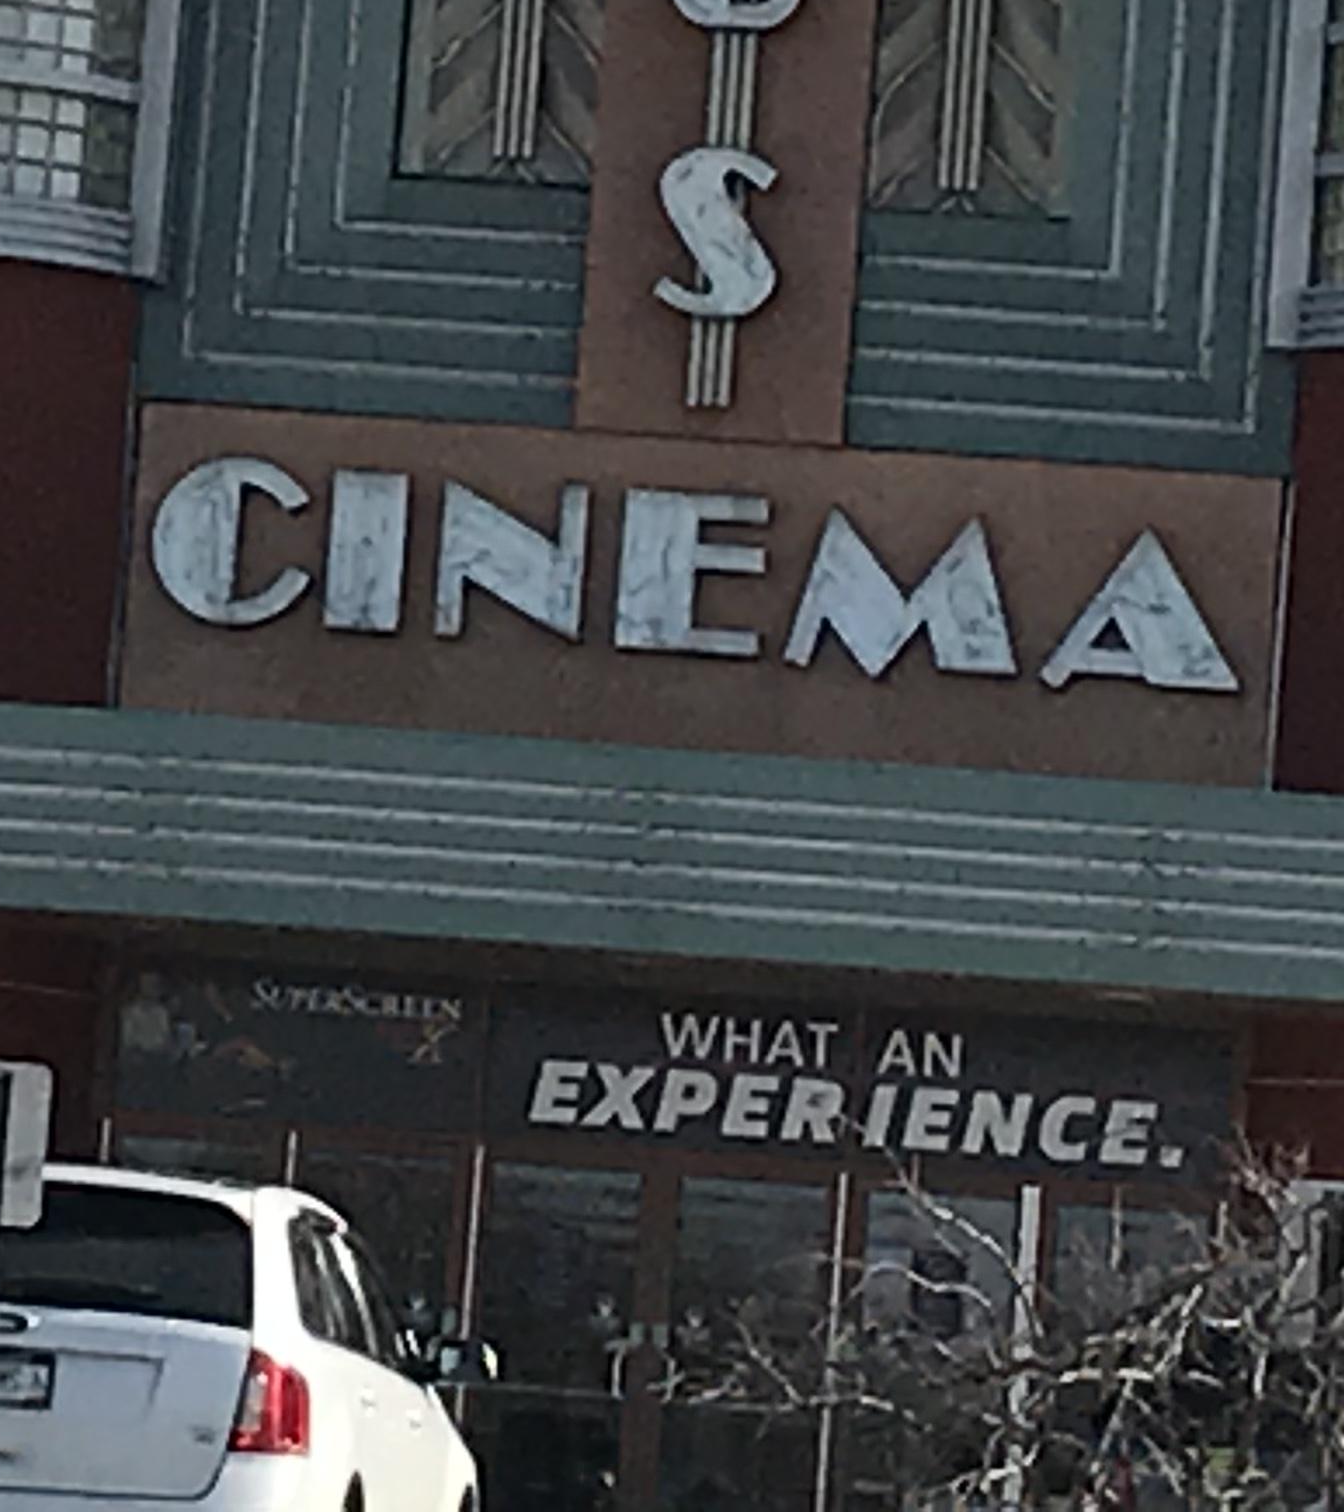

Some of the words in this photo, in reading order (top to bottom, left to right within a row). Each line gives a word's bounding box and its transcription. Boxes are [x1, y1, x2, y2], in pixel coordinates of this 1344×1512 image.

[151, 456, 1240, 693] CINEMA
[660, 1013, 839, 1068] WHAT
[878, 1029, 962, 1078] AN
[528, 1059, 1186, 1169] EXPERIENCE.
